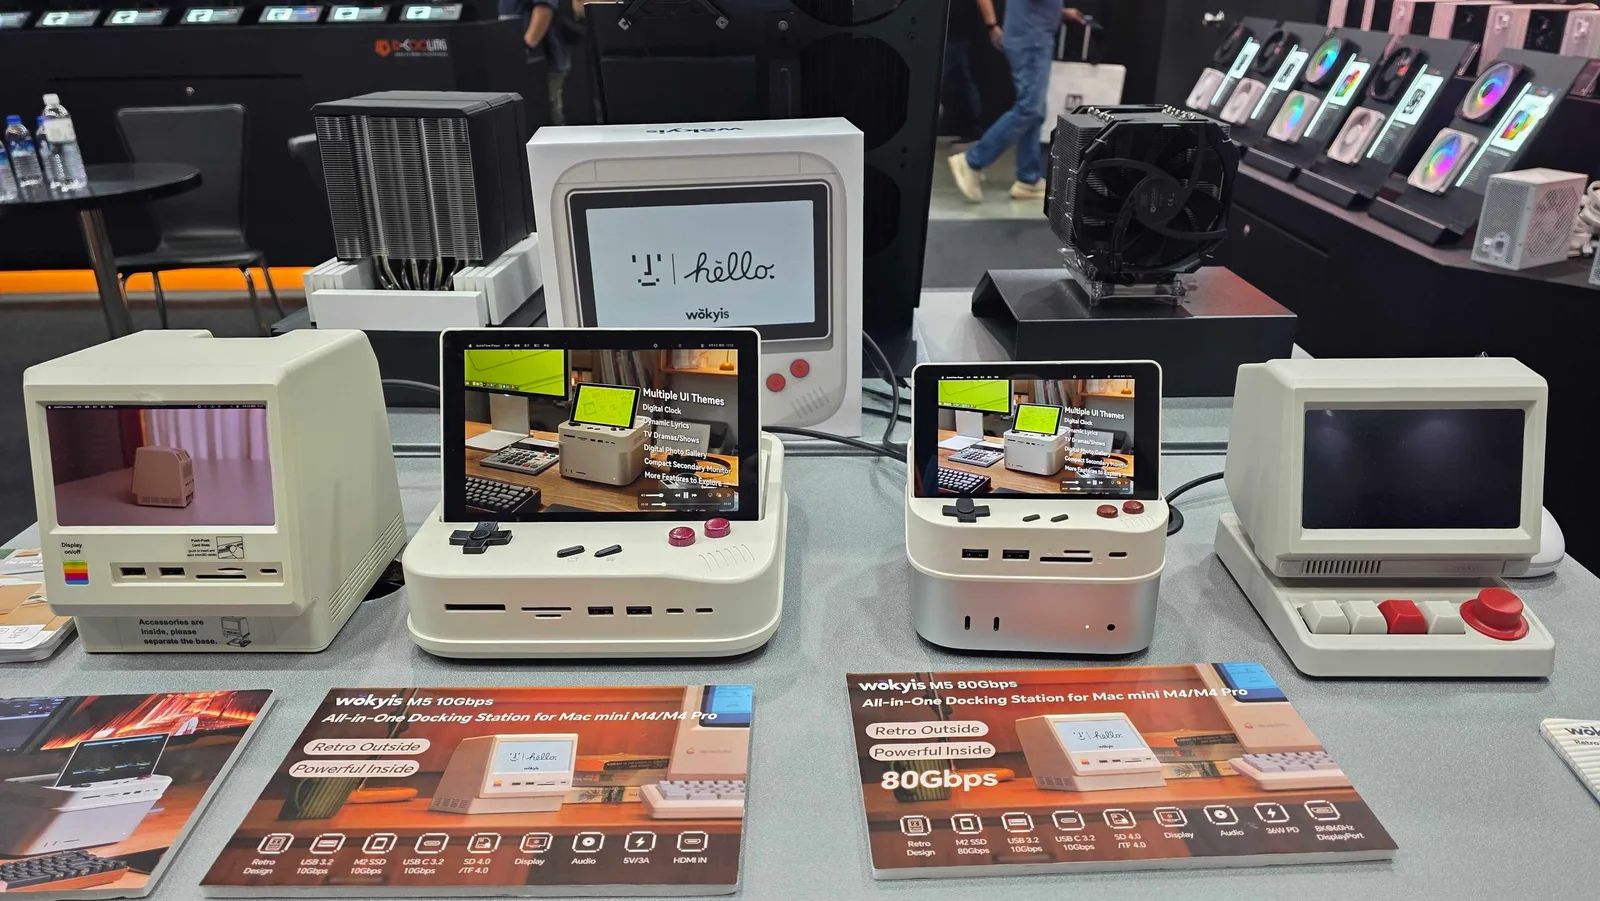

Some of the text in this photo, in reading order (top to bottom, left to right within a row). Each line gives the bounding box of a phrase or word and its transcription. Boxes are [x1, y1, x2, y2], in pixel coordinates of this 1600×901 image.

[642, 387, 725, 406] Multiple UI Themes
[642, 403, 682, 415] Digital Clock
[1064, 406, 1091, 416] Multiple
[1099, 410, 1125, 420] Themes
[643, 417, 690, 430] Dynamic Lyrics
[1064, 417, 1080, 425] Digital
[643, 430, 700, 444] TV Dramas/Shows
[643, 443, 707, 460] Digital Photo Gallery
[644, 457, 731, 474] Compact Secondary Monitor
[644, 471, 722, 489] More Features to Explore
[141, 628, 197, 636] inside, please
[930, 681, 953, 690] M5
[957, 680, 1018, 690] 80Gbps
[862, 687, 1248, 708] All-in-One Docking Station for Mac mini M4/M4 Pro
[407, 698, 432, 706] M5
[436, 698, 494, 707] 10Gbps
[321, 711, 718, 724] All-in-One Docking Station for Mac mini M4/M4 Pro
[875, 724, 980, 735] Retro Outside
[312, 742, 421, 752] Retro Outside
[874, 745, 991, 757] Powerful Inside
[293, 764, 415, 774] Powerful Inside
[881, 769, 998, 792] 80Gbps
[1220, 828, 1245, 837] Audio
[1265, 826, 1285, 834] 36W
[1314, 824, 1355, 832] 8K@60Hz
[1026, 836, 1040, 844] 3.2
[1082, 834, 1096, 842] 3.2
[1163, 832, 1194, 840] Display
[1316, 832, 1365, 841] DisplayPort
[1010, 845, 1043, 853] 10Gbps
[1063, 843, 1095, 851] 10Gbps
[1133, 841, 1147, 849] 4.0
[906, 849, 936, 857] Design
[957, 847, 990, 855] 80Gbps
[251, 858, 276, 866] Retro
[300, 858, 335, 866] USB 3.2
[403, 858, 445, 866] USB C 3.2
[514, 858, 545, 867] Display
[571, 857, 597, 865] Audio
[243, 867, 273, 876] Design
[296, 867, 328, 875] 10Gbps
[350, 867, 382, 875] 10Gbps
[403, 867, 436, 875] 10Gbps
